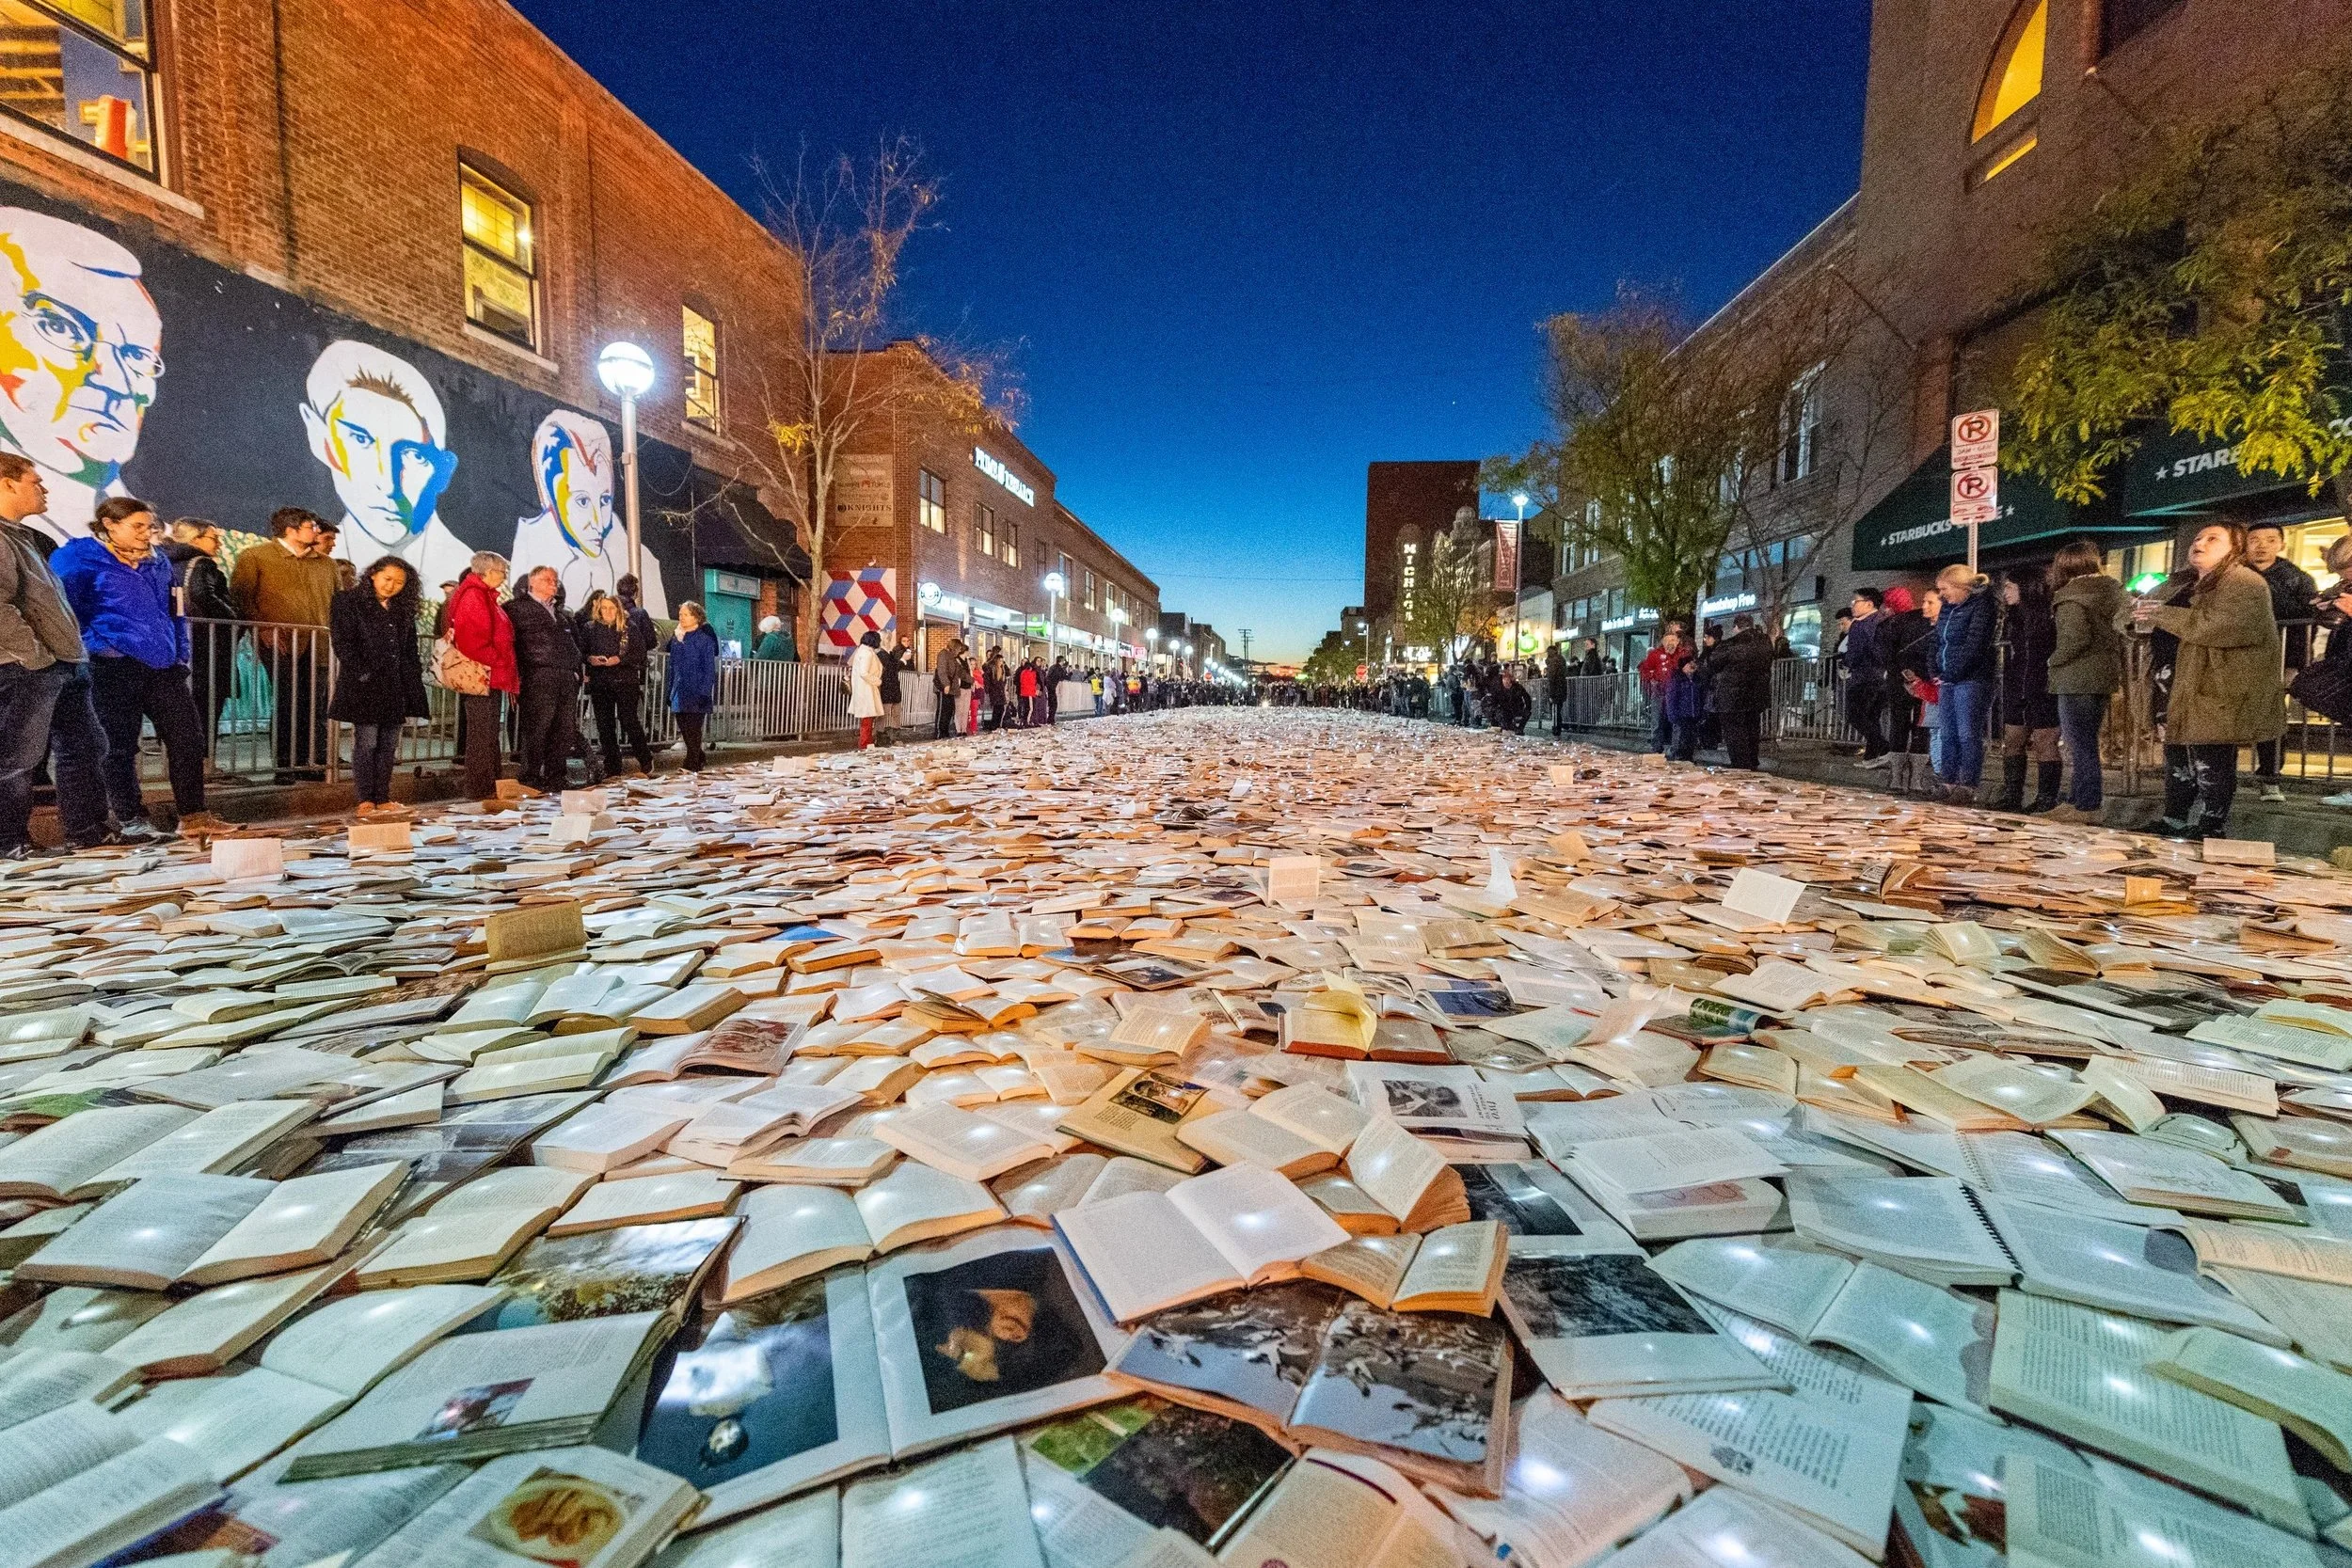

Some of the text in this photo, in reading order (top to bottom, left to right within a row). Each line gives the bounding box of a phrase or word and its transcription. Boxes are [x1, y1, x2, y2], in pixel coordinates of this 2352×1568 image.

[2172, 446, 2242, 478] STARB
[1888, 518, 1952, 546] STARBUCKS
[1738, 593, 1756, 608] Free
